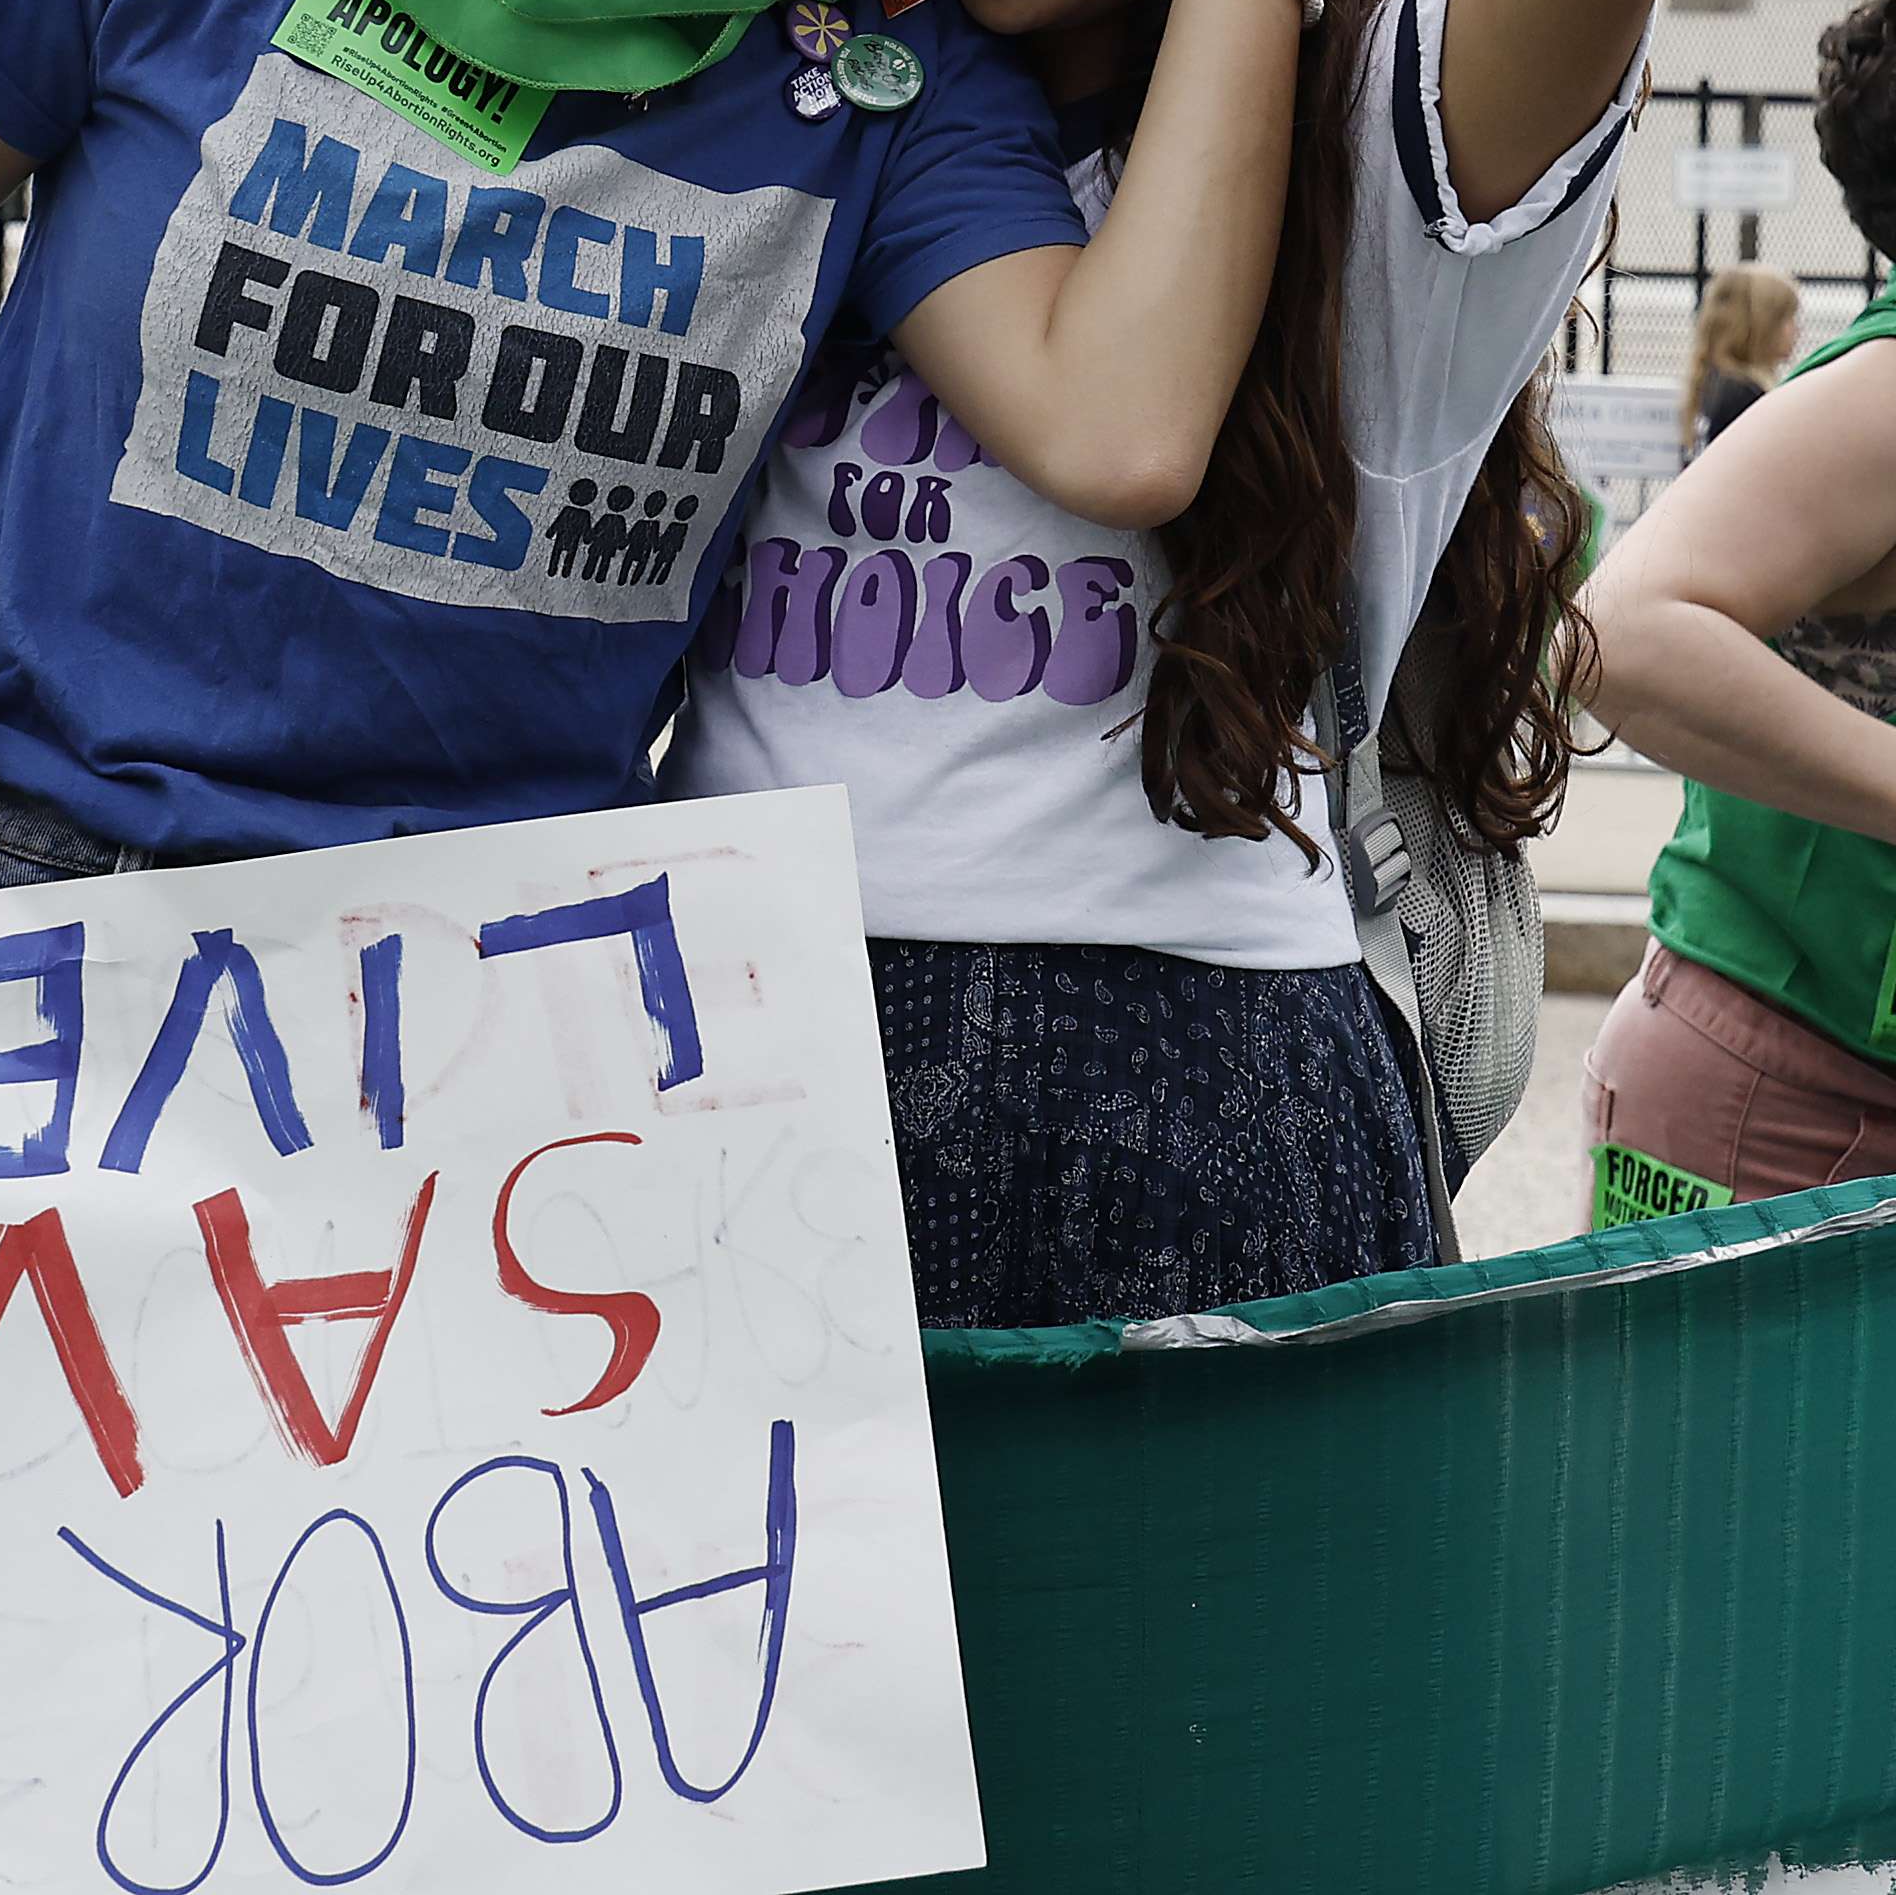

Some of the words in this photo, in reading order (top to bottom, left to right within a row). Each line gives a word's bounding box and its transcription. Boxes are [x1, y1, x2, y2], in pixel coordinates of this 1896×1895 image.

[330, 54, 502, 169] RiseUp4AbortionRights.org
[791, 67, 821, 90] TAKE
[793, 71, 833, 102] ACTION
[228, 117, 705, 337] MARCH
[194, 240, 476, 421] FOR
[480, 324, 741, 474] OUR
[175, 368, 552, 572] LIVES
[827, 461, 954, 543] FOR
